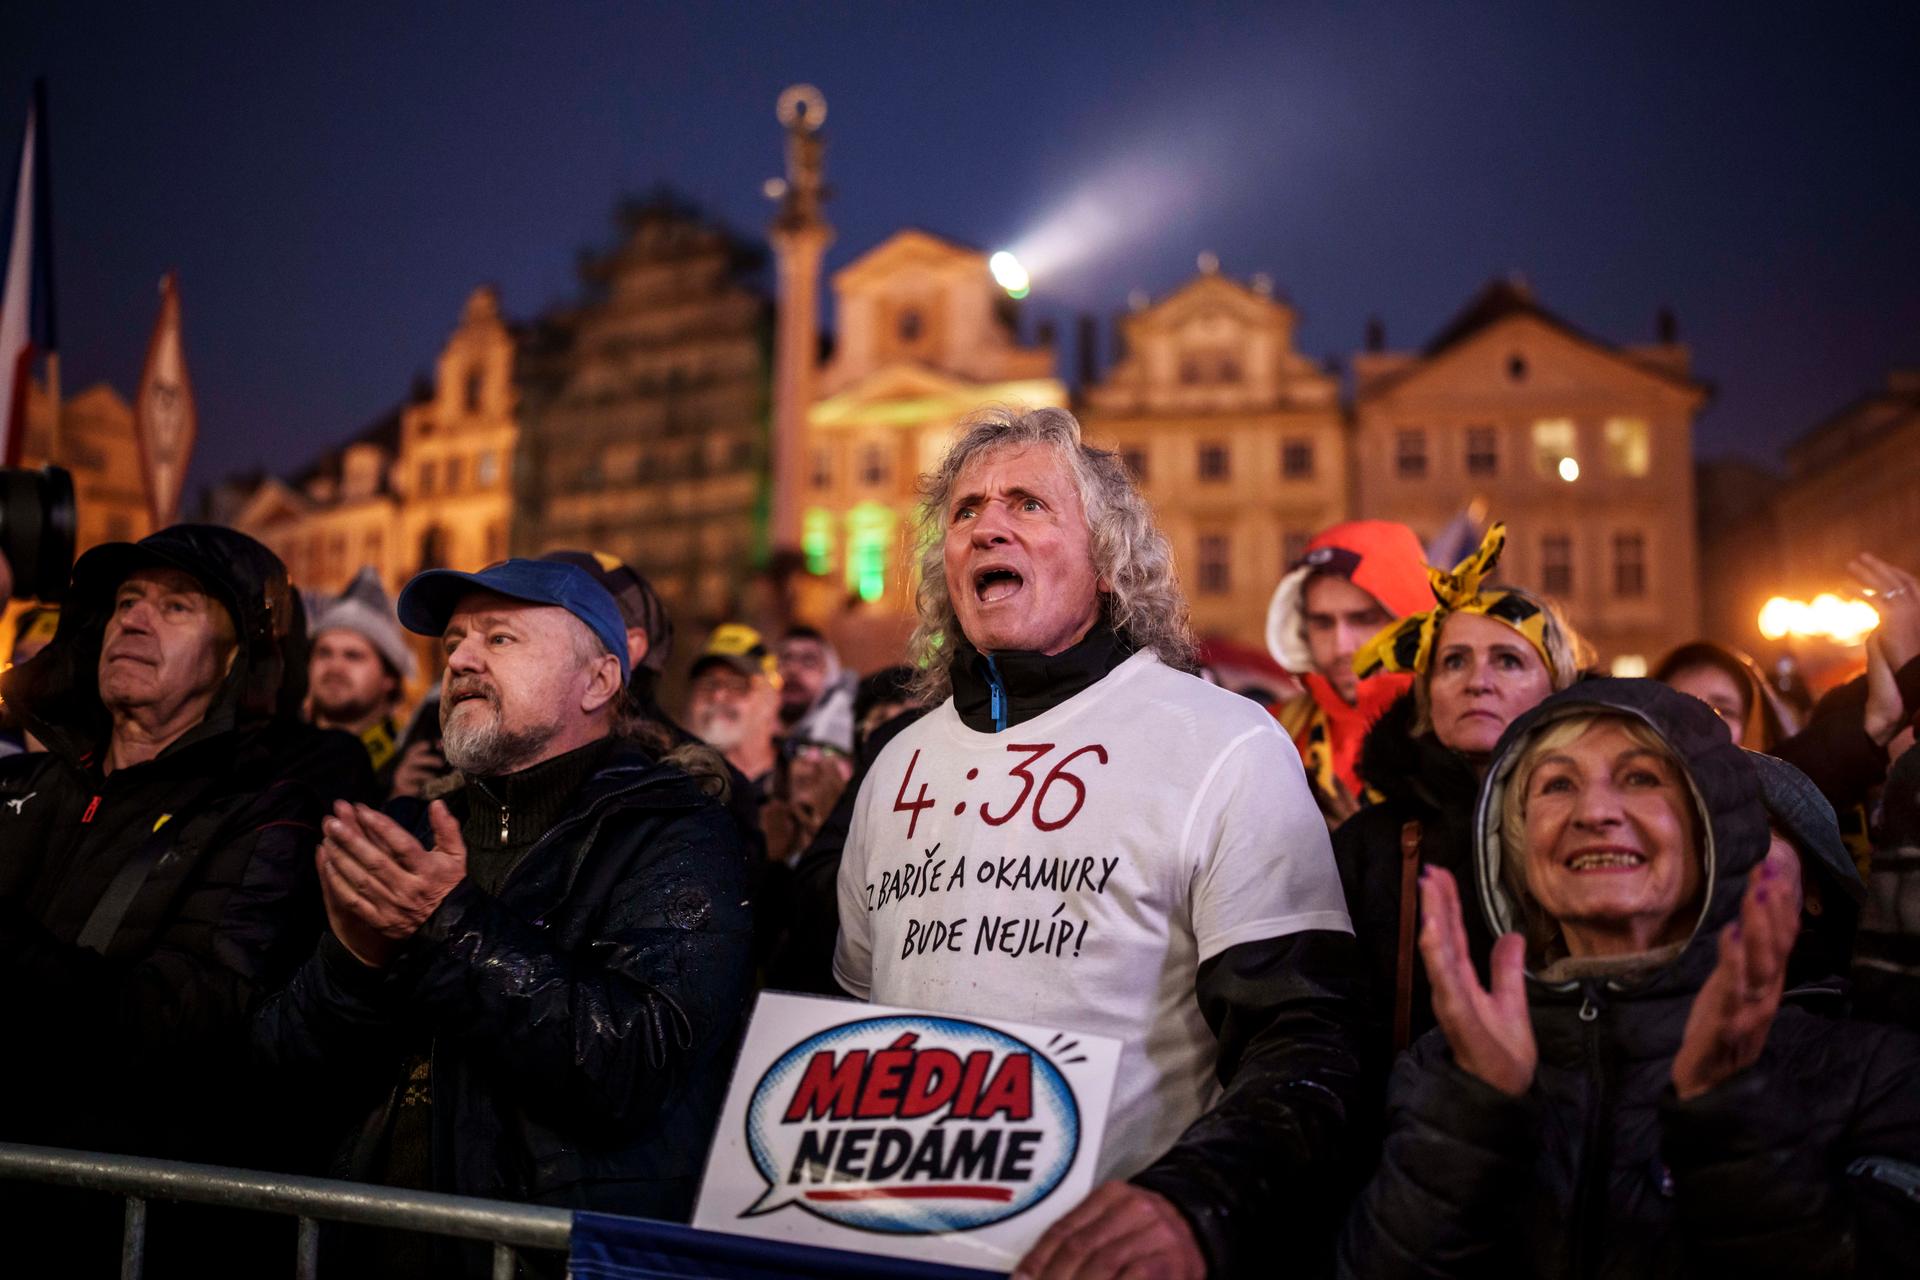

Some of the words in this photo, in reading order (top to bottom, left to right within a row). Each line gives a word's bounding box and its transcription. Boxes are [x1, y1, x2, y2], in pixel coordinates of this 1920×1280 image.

[893, 743, 1108, 839] 4:36
[877, 843, 946, 911] BABIŠE
[947, 855, 966, 891] A
[977, 855, 1119, 894] OKAMURY
[901, 918, 967, 960] BUDE
[974, 902, 1088, 957] NEJLÍP!
[781, 1032, 1034, 1125] MÉDIA
[788, 1116, 1043, 1185] NEDÁME
